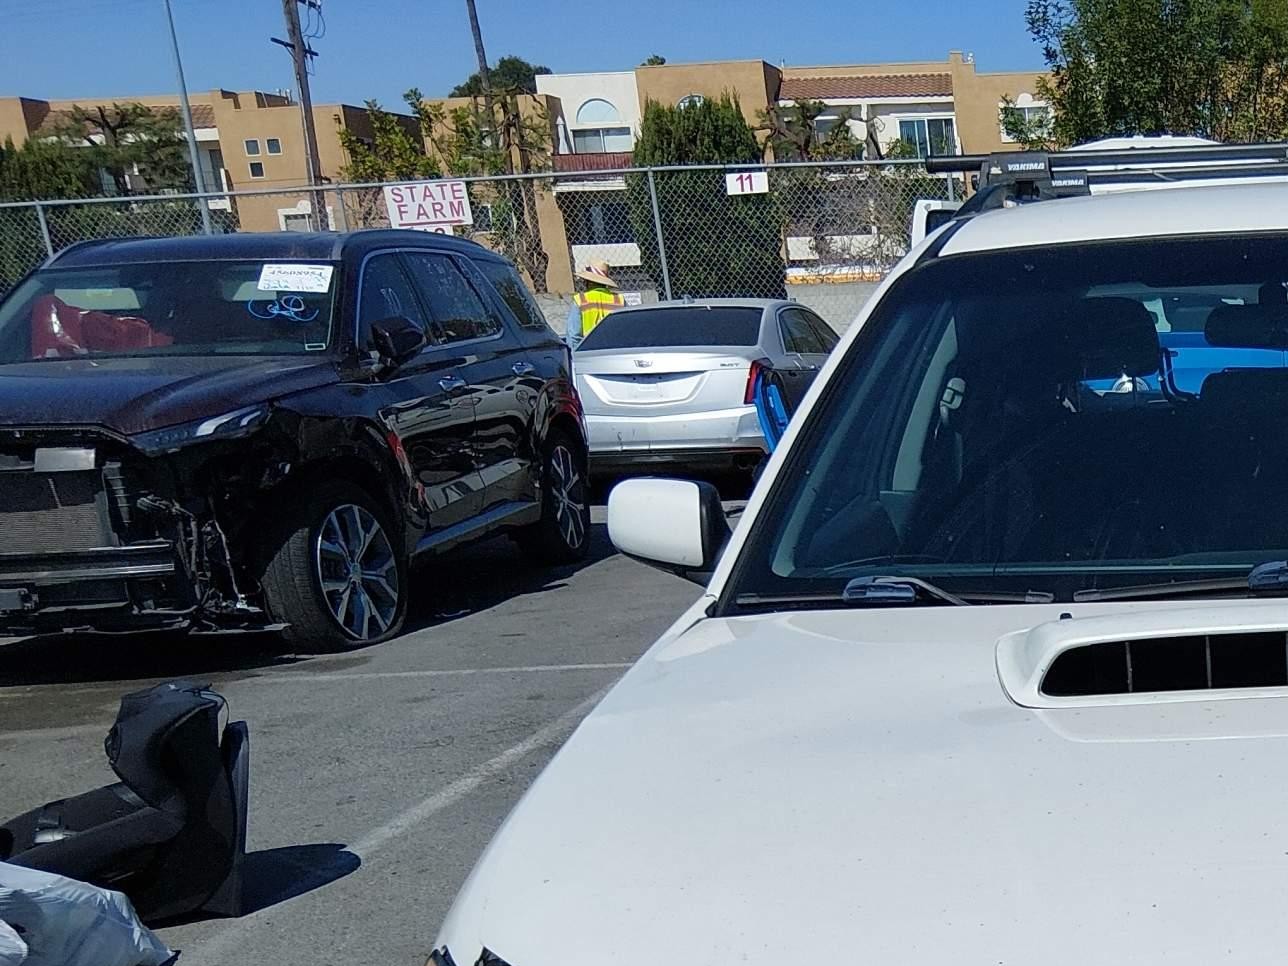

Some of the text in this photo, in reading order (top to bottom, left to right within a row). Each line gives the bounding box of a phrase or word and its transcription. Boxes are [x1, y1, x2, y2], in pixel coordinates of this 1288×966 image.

[1008, 162, 1045, 171] YAKIMA
[736, 174, 753, 192] 11
[1052, 179, 1084, 187] YAKIMA
[391, 183, 464, 203] STATE
[396, 200, 465, 220] FARM
